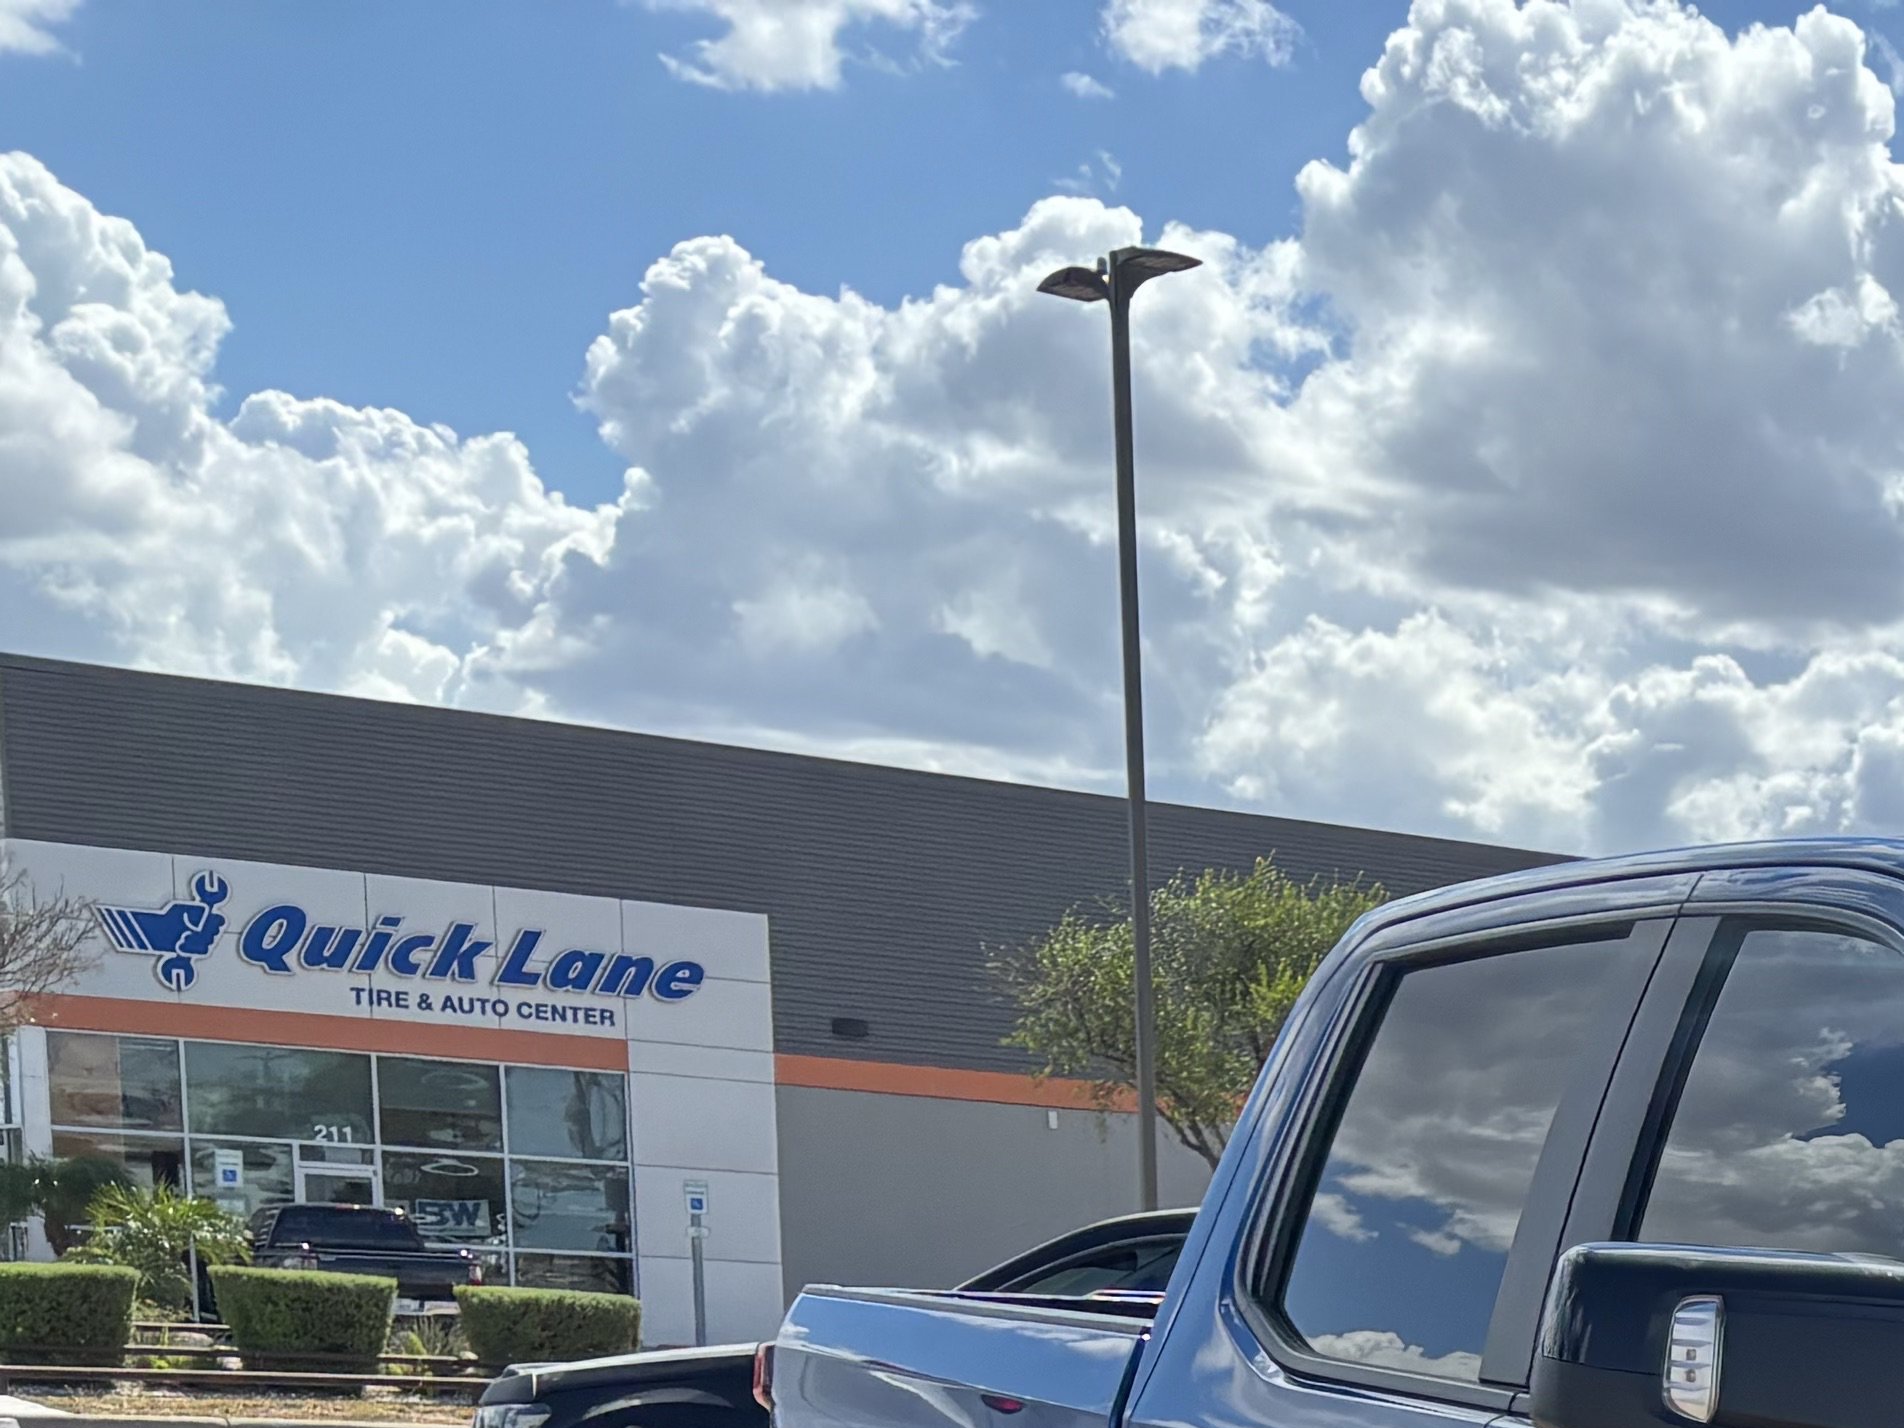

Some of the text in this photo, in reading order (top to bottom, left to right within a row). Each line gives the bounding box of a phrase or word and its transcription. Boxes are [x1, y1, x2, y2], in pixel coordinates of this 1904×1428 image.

[239, 903, 706, 1001] Quick Lane
[350, 987, 616, 1027] TIRE & AUTO CENTER
[314, 1124, 352, 1143] 211
